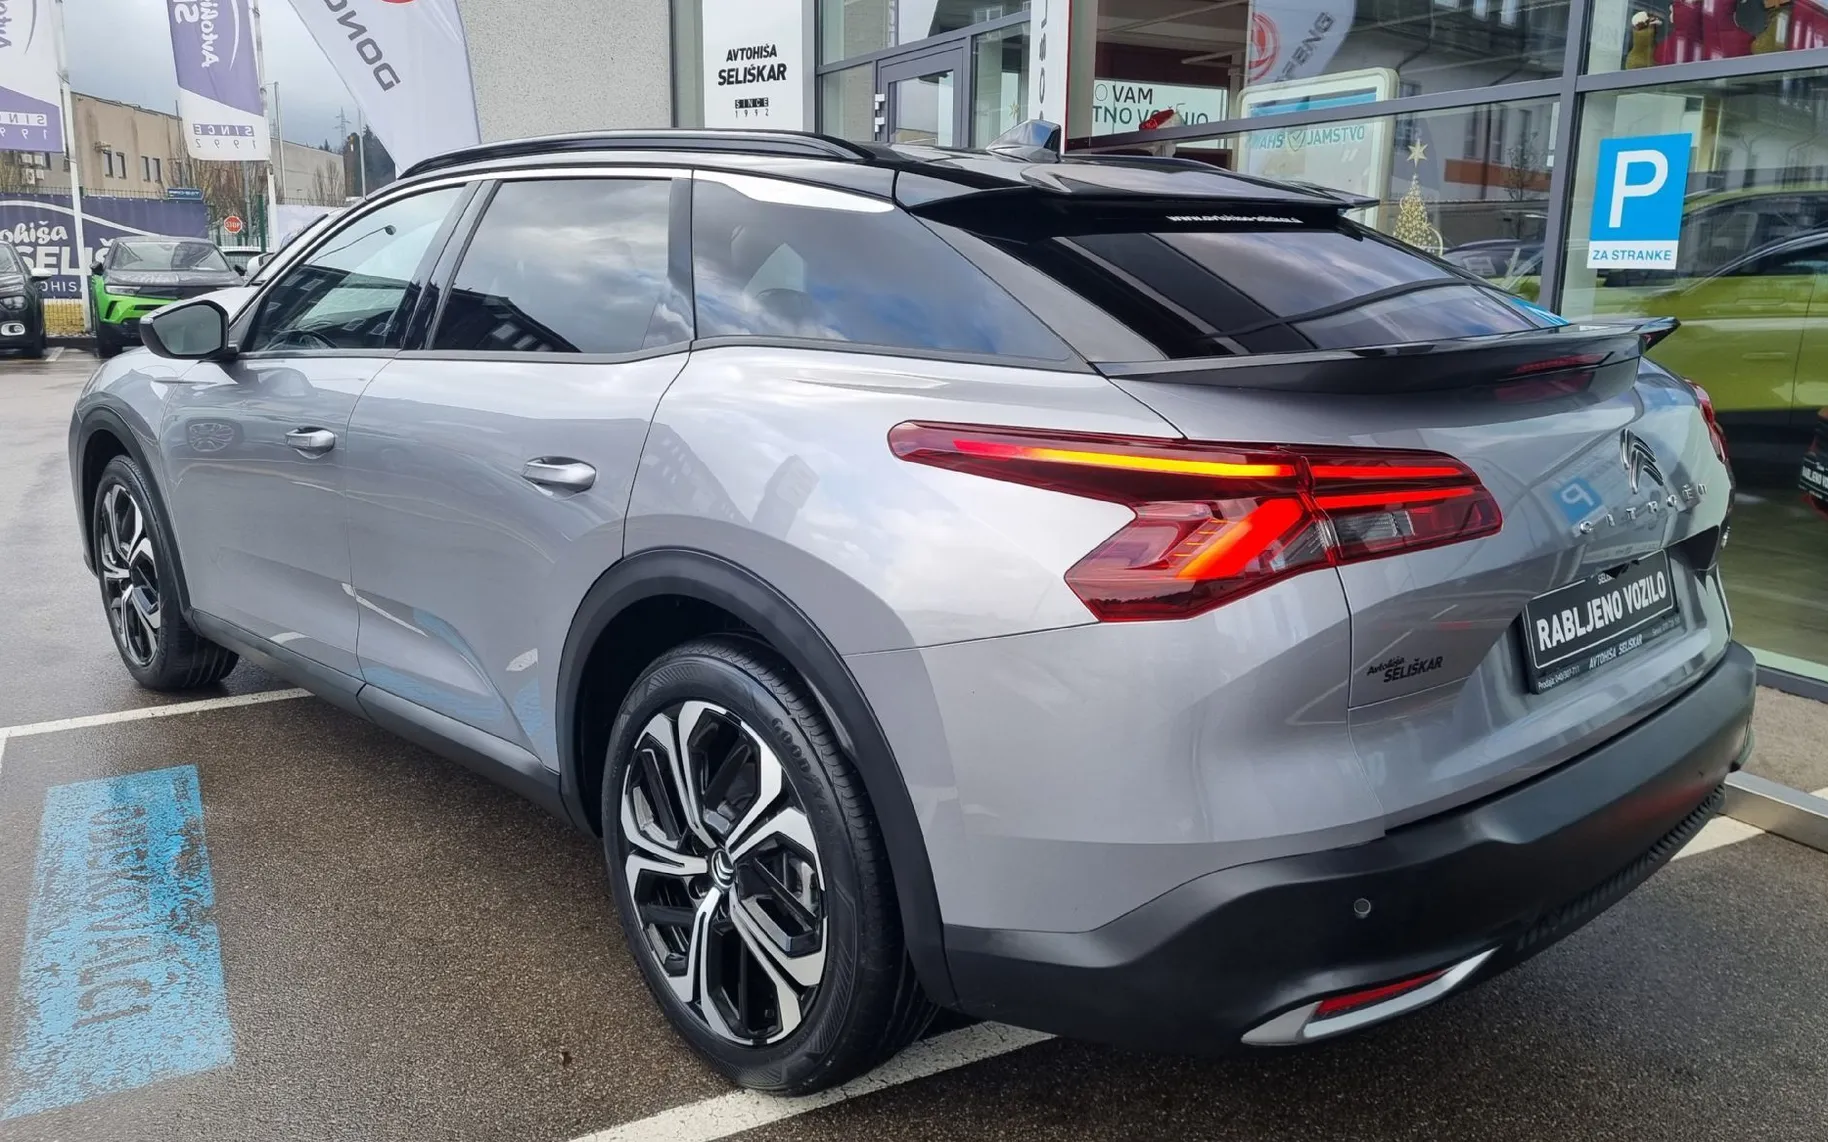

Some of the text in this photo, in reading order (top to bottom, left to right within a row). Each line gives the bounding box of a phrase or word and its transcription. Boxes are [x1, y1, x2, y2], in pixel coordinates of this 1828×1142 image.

[726, 43, 777, 62] AVTOHIŠA
[718, 63, 787, 86] SELIŠKAR
[735, 97, 769, 109] SINCE
[1112, 85, 1153, 105] VAM
[735, 108, 769, 118] 1992
[1307, 126, 1365, 145] JAMSTVO
[1608, 149, 1669, 228] P
[1592, 249, 1672, 261] ZA STRANKE
[1579, 483, 1708, 535] CITROËN
[1536, 590, 1623, 652] RABLJENO
[1623, 570, 1667, 615] VOZILO
[1588, 646, 1617, 670] AVTOHIŠA
[1384, 656, 1443, 683] SELIŠKAR
